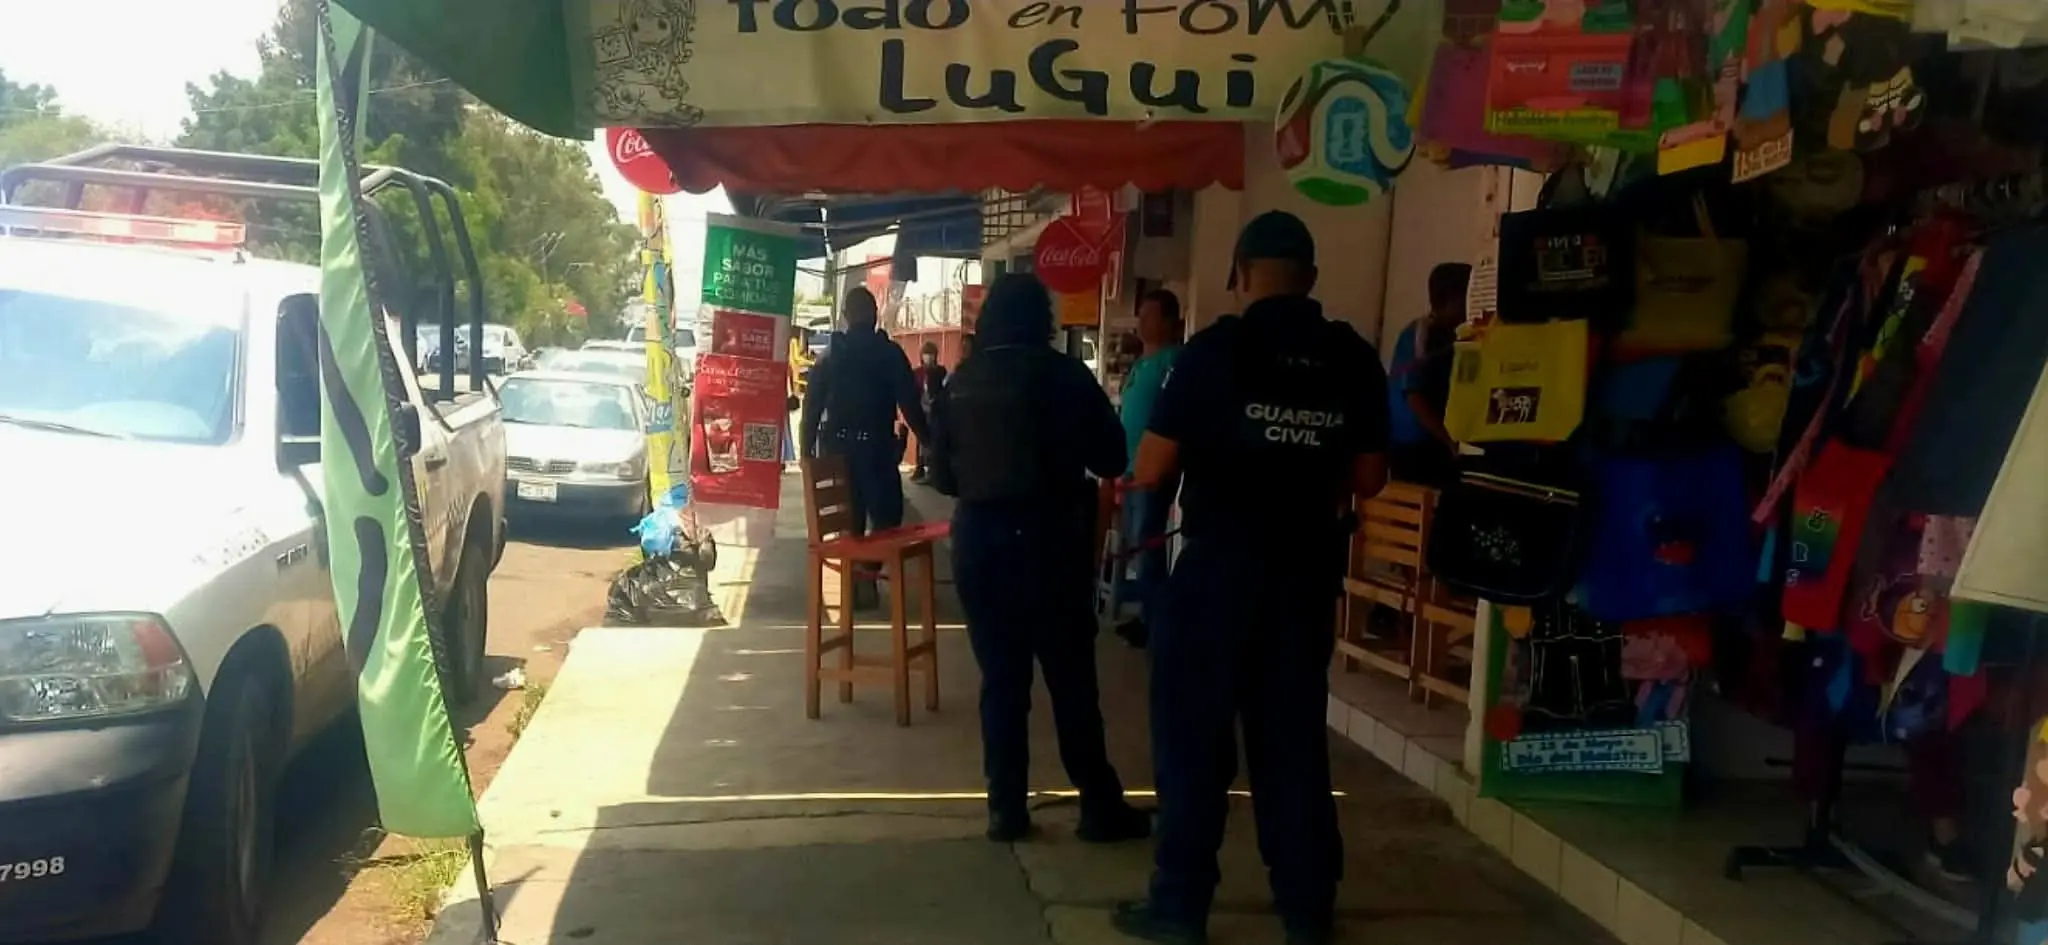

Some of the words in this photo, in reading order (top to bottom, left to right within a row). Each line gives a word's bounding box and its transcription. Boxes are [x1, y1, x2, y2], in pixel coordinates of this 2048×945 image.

[1008, 0, 1082, 28] en
[879, 39, 1258, 115] LuGui
[1244, 402, 1345, 428] GUARDIA
[1264, 425, 1321, 447] CIVIL
